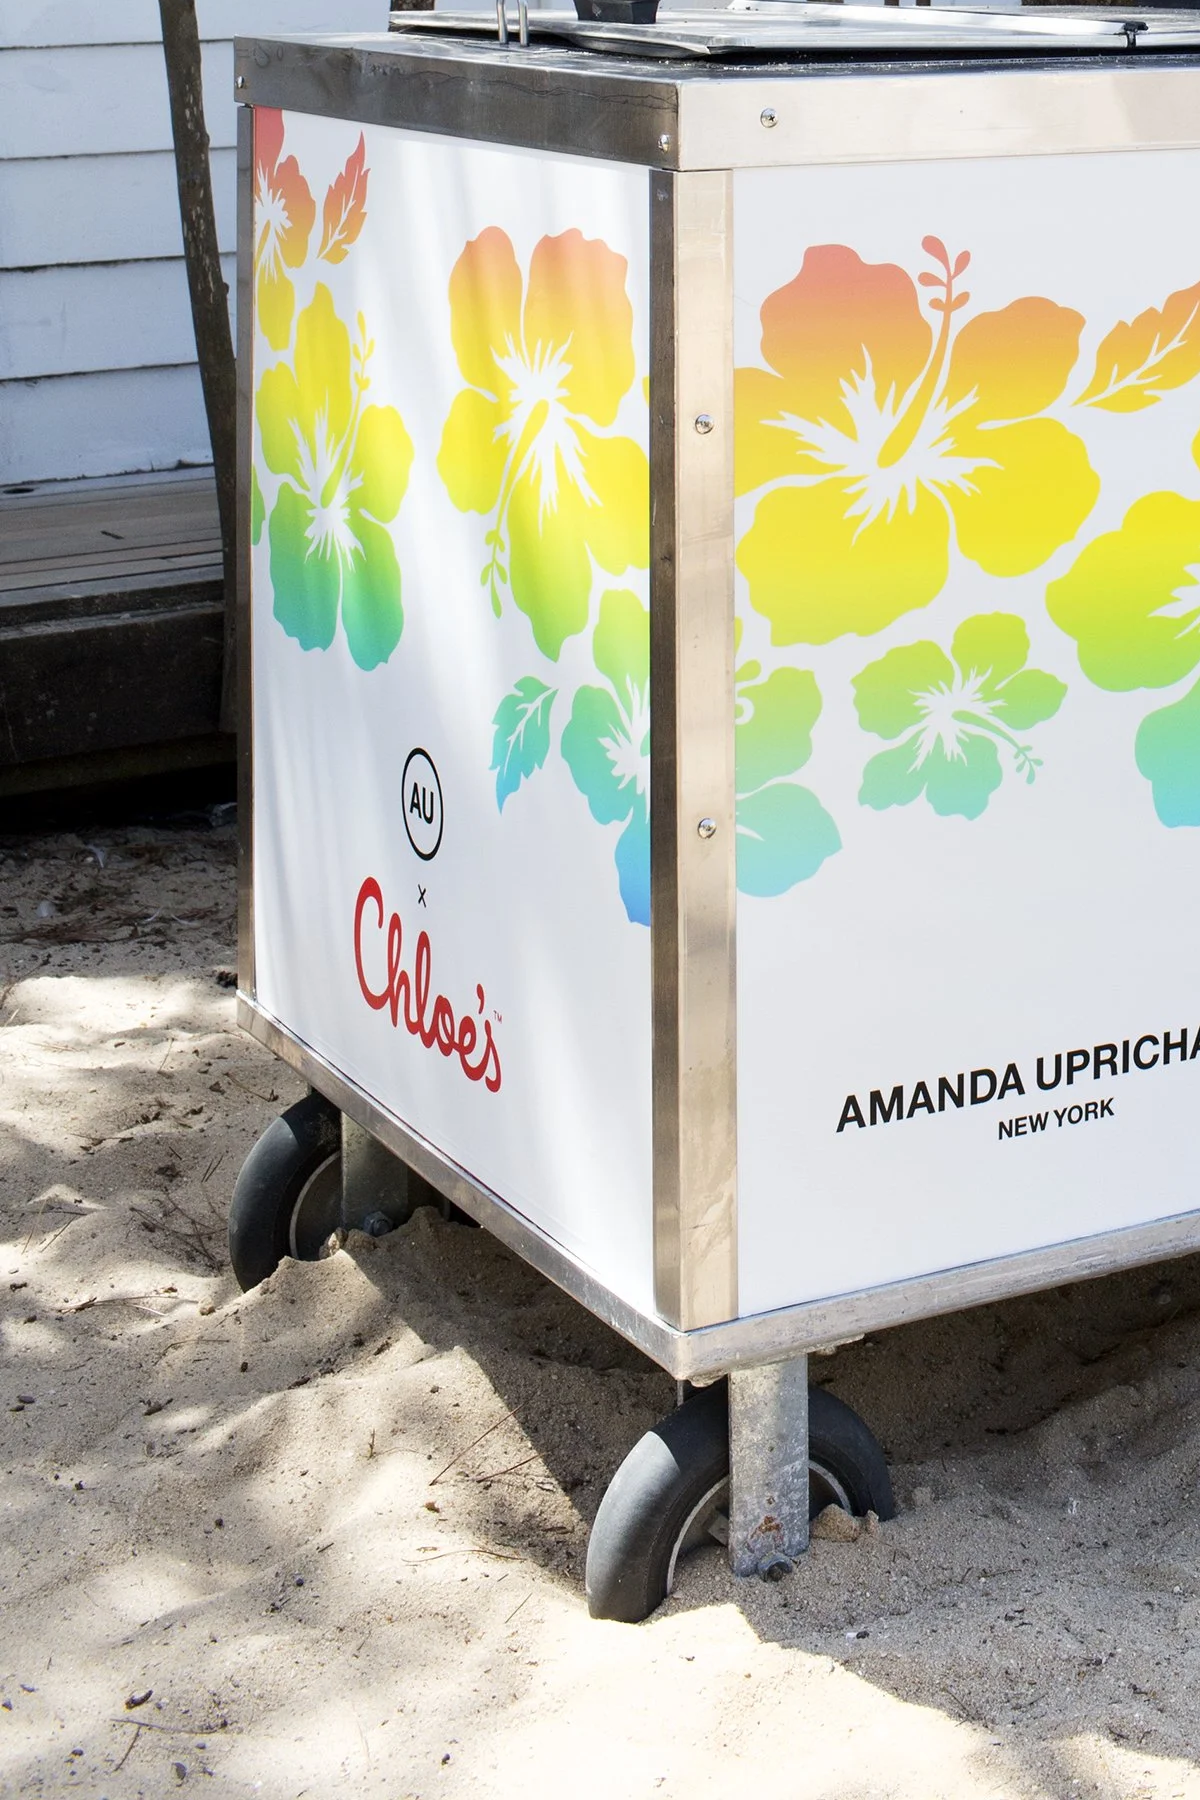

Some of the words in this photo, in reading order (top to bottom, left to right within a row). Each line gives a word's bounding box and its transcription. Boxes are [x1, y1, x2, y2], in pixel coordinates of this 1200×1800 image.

[409, 782, 434, 825] AU
[354, 876, 501, 1093] Chloe's
[836, 1062, 1026, 1133] AMANDA
[998, 1111, 1050, 1141] NEW
[1053, 1097, 1115, 1128] YORK
